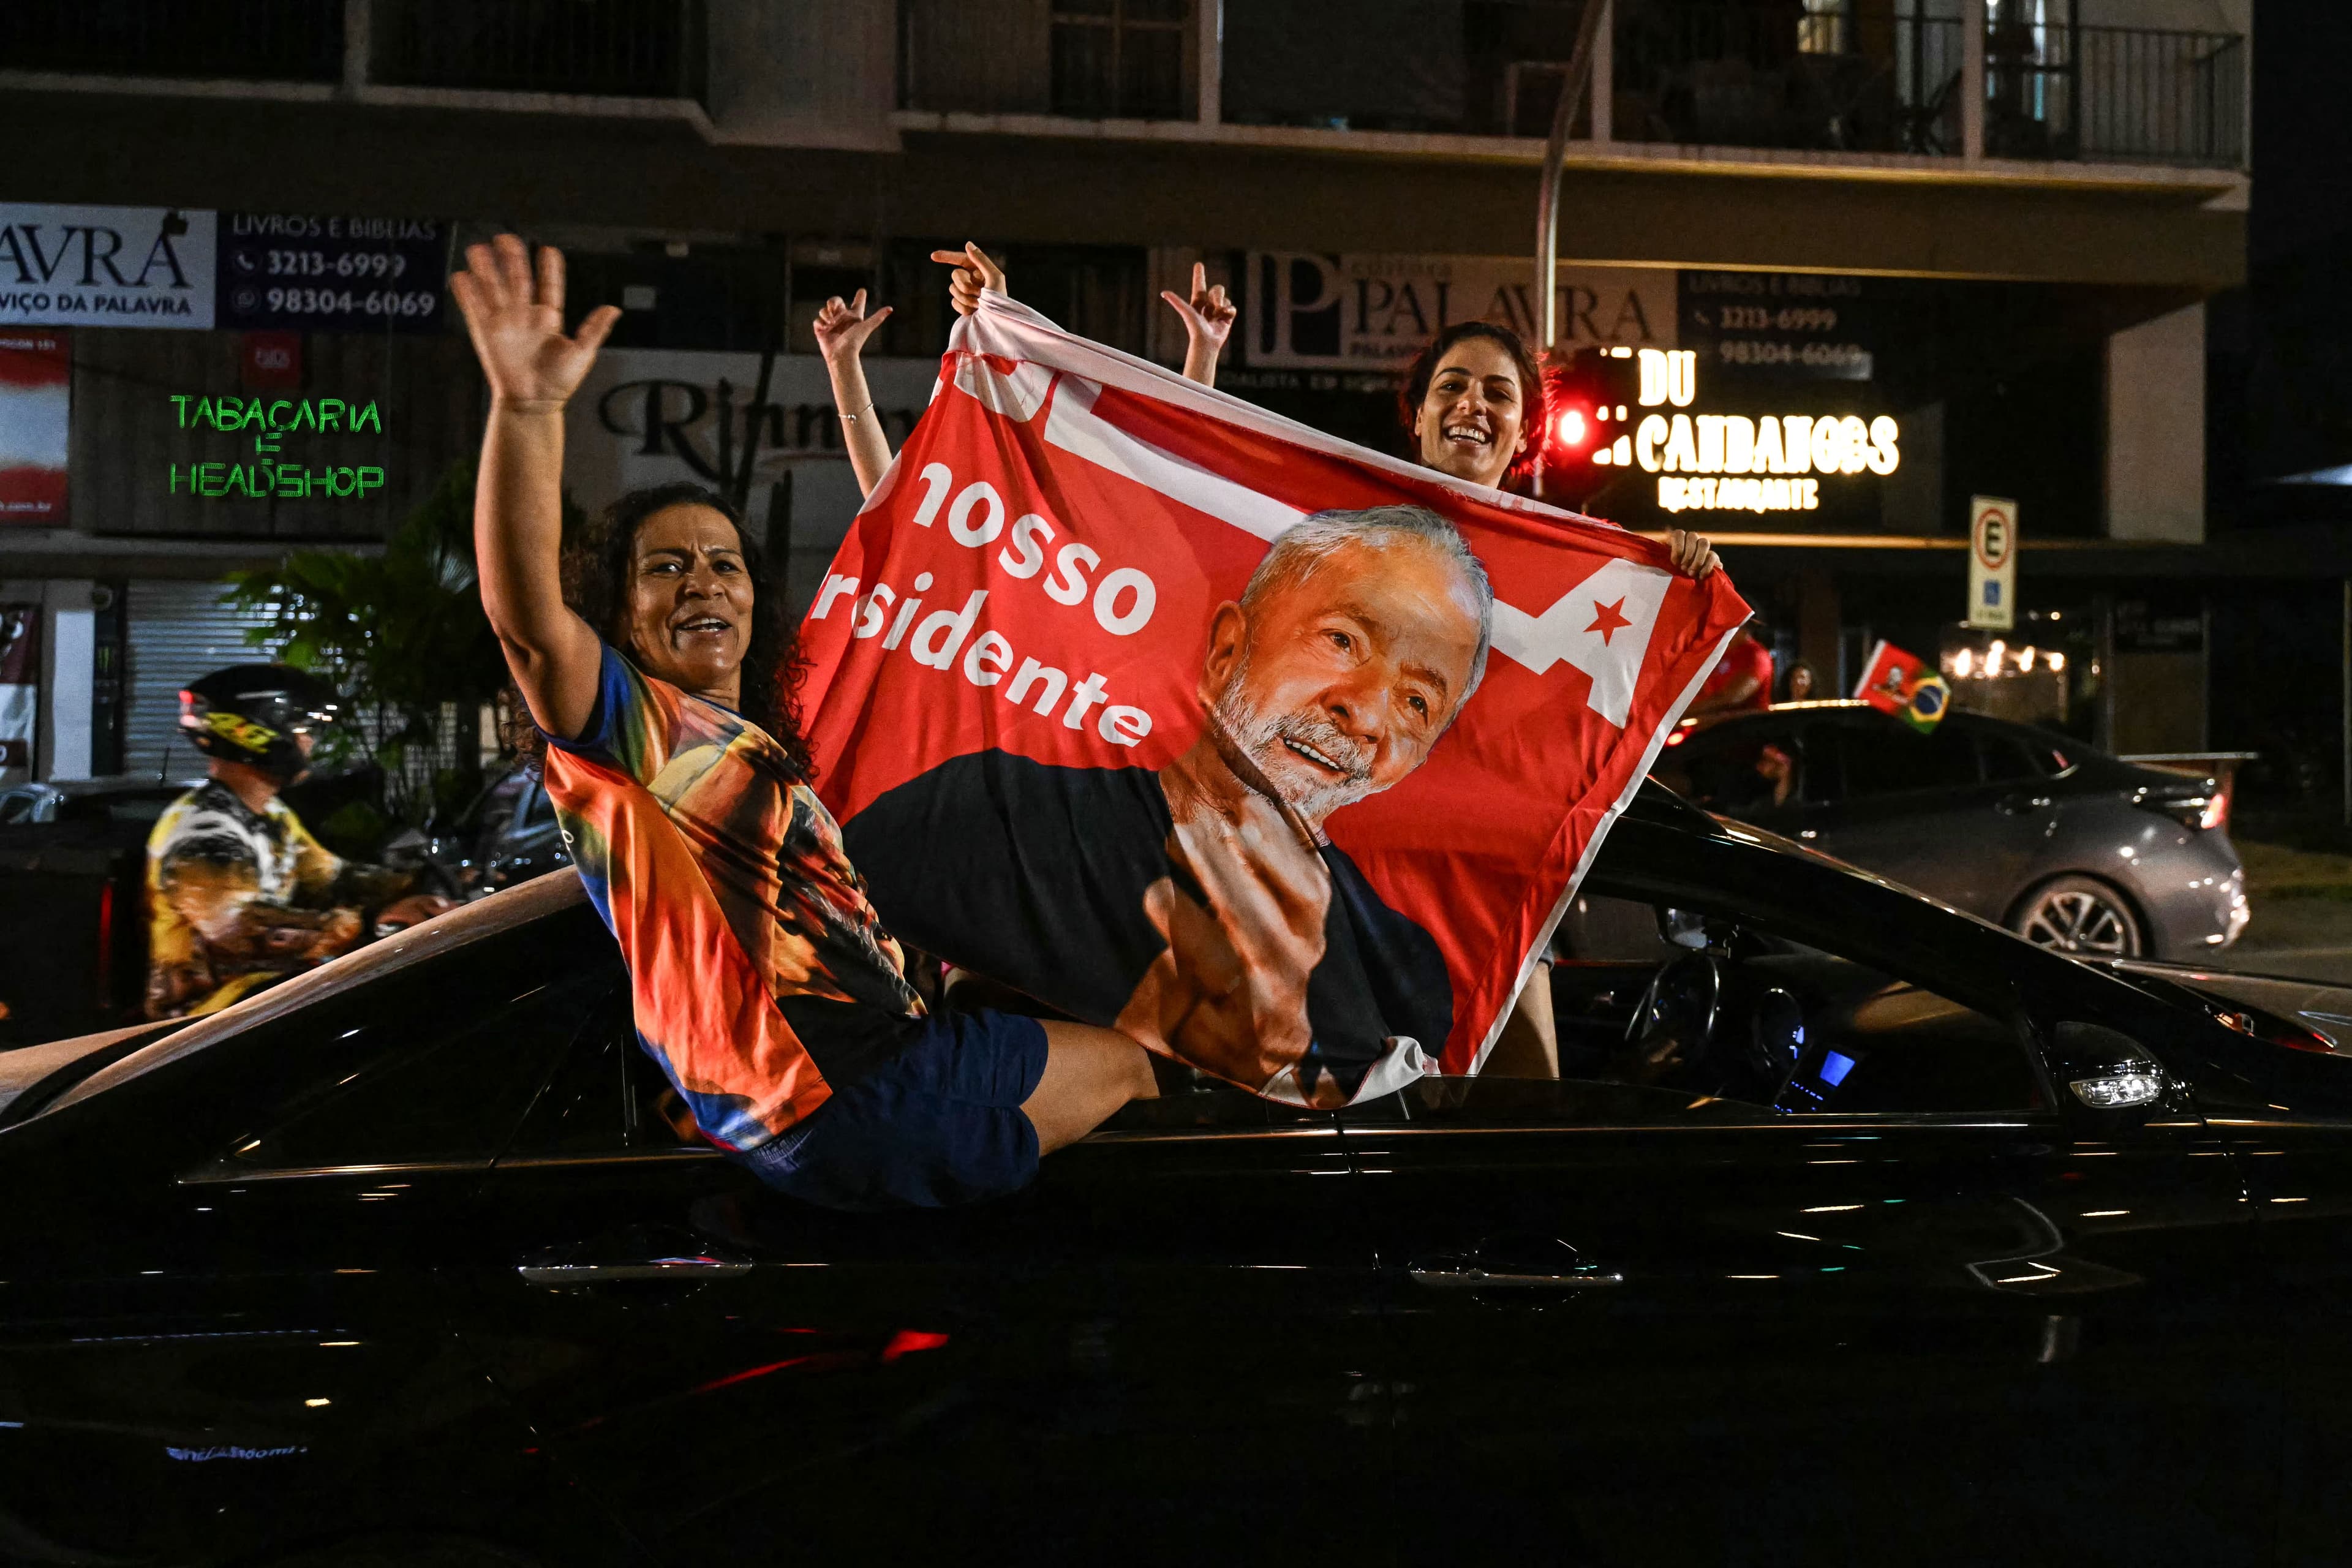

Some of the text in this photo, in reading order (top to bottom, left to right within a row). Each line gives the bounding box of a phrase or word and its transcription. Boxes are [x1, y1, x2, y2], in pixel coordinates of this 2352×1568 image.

[233, 213, 321, 238] LIVROS
[328, 216, 343, 238] E
[267, 249, 407, 277] 3213-6999
[58, 295, 87, 312] DA
[96, 295, 192, 315] PALAVRA
[266, 286, 436, 317] 98304-6069
[1637, 348, 1697, 407] DU
[170, 394, 382, 434] TABACARIA
[170, 462, 384, 498] HEADSHOP
[1985, 521, 2001, 557] E
